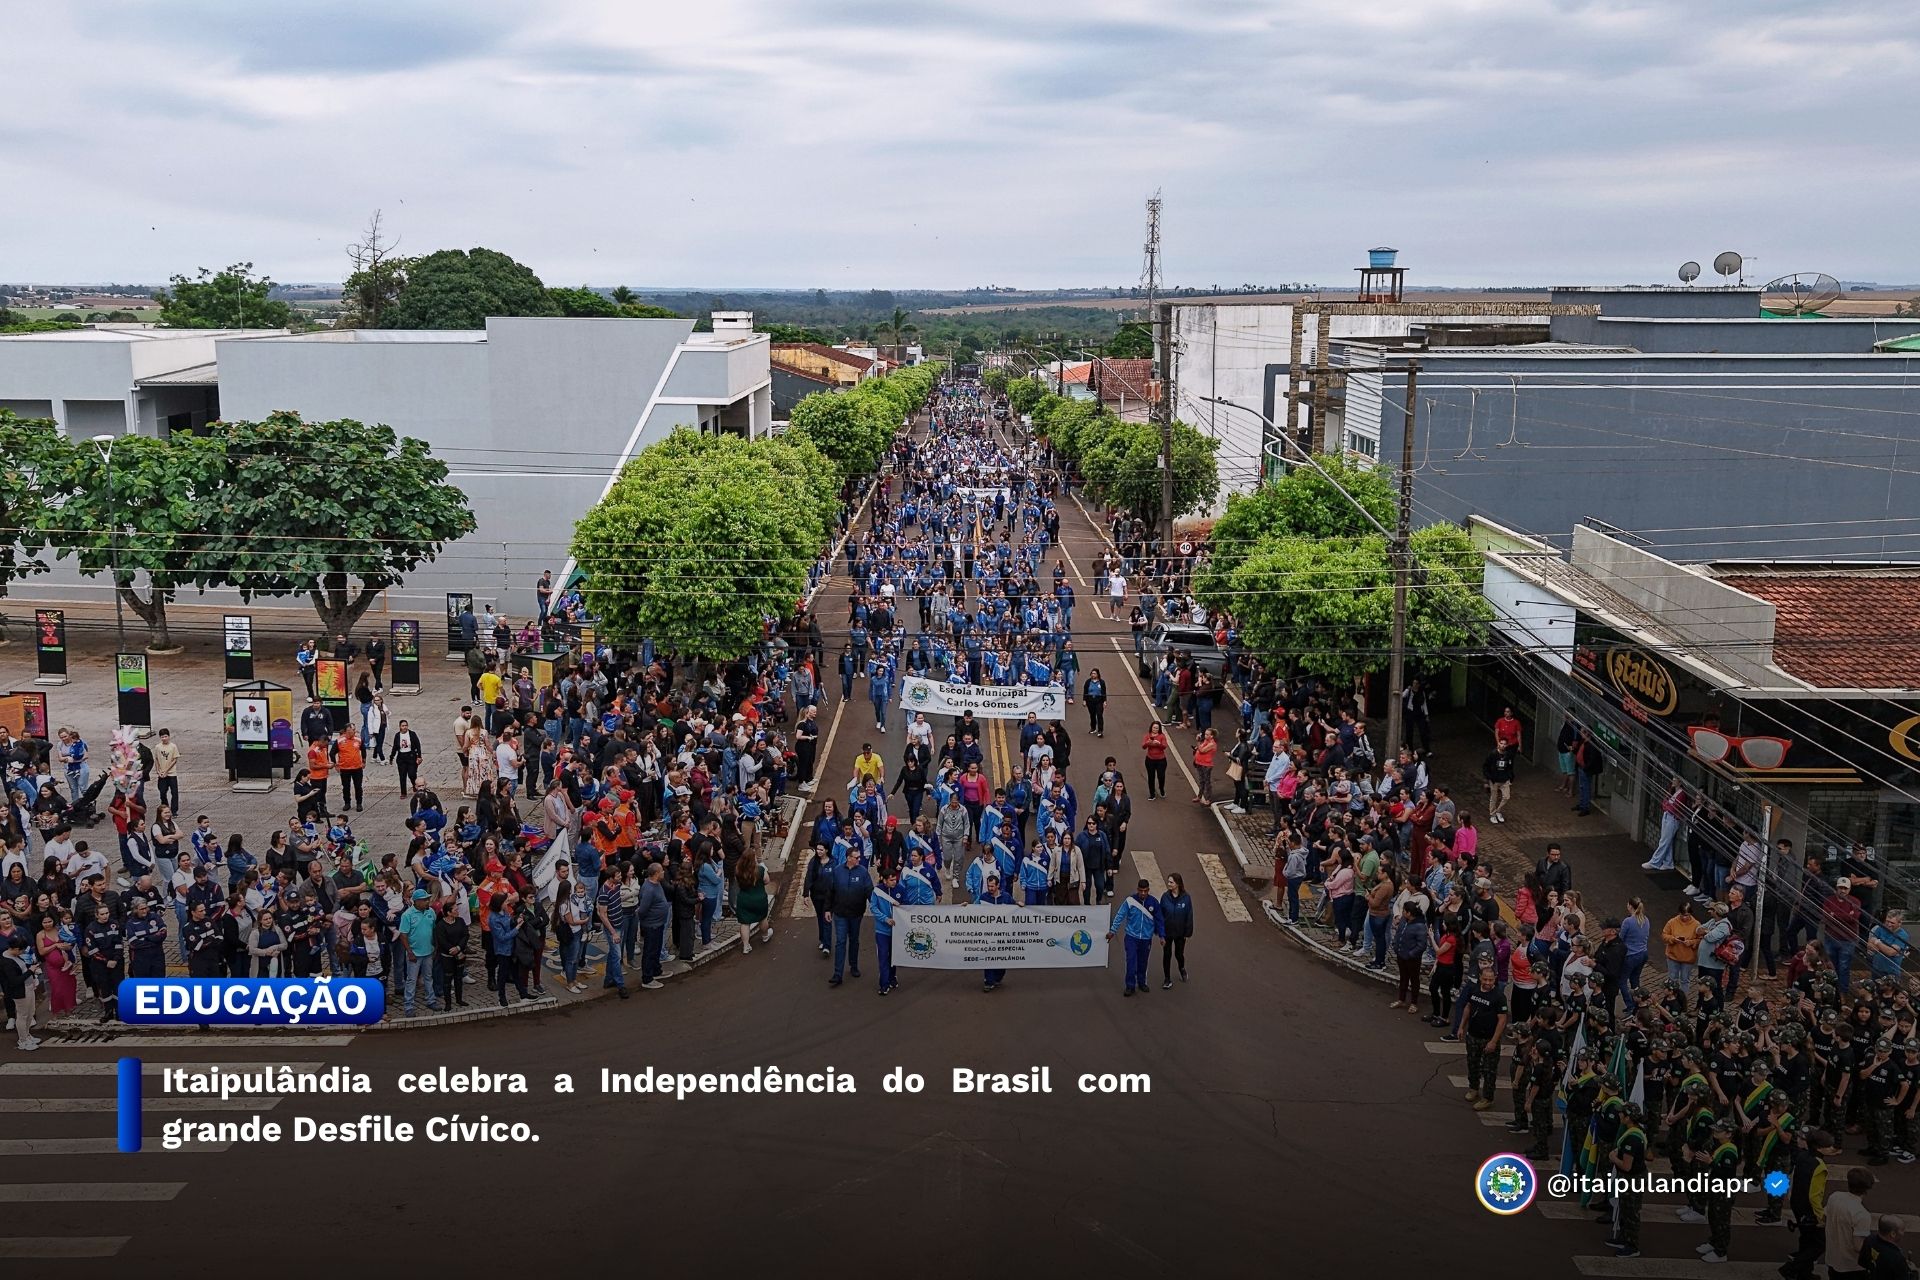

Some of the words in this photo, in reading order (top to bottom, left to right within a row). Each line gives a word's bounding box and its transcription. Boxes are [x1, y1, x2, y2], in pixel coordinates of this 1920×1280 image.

[1614, 651, 1667, 703] status
[939, 685, 972, 696] Escola
[975, 687, 1028, 698] Municipal
[947, 698, 979, 708] Carlos
[982, 700, 1019, 709] Gomes
[910, 914, 951, 924] ESCOLA
[953, 914, 1009, 924] MUNICIPAL
[1011, 914, 1087, 924] MULTI-EDUCAR
